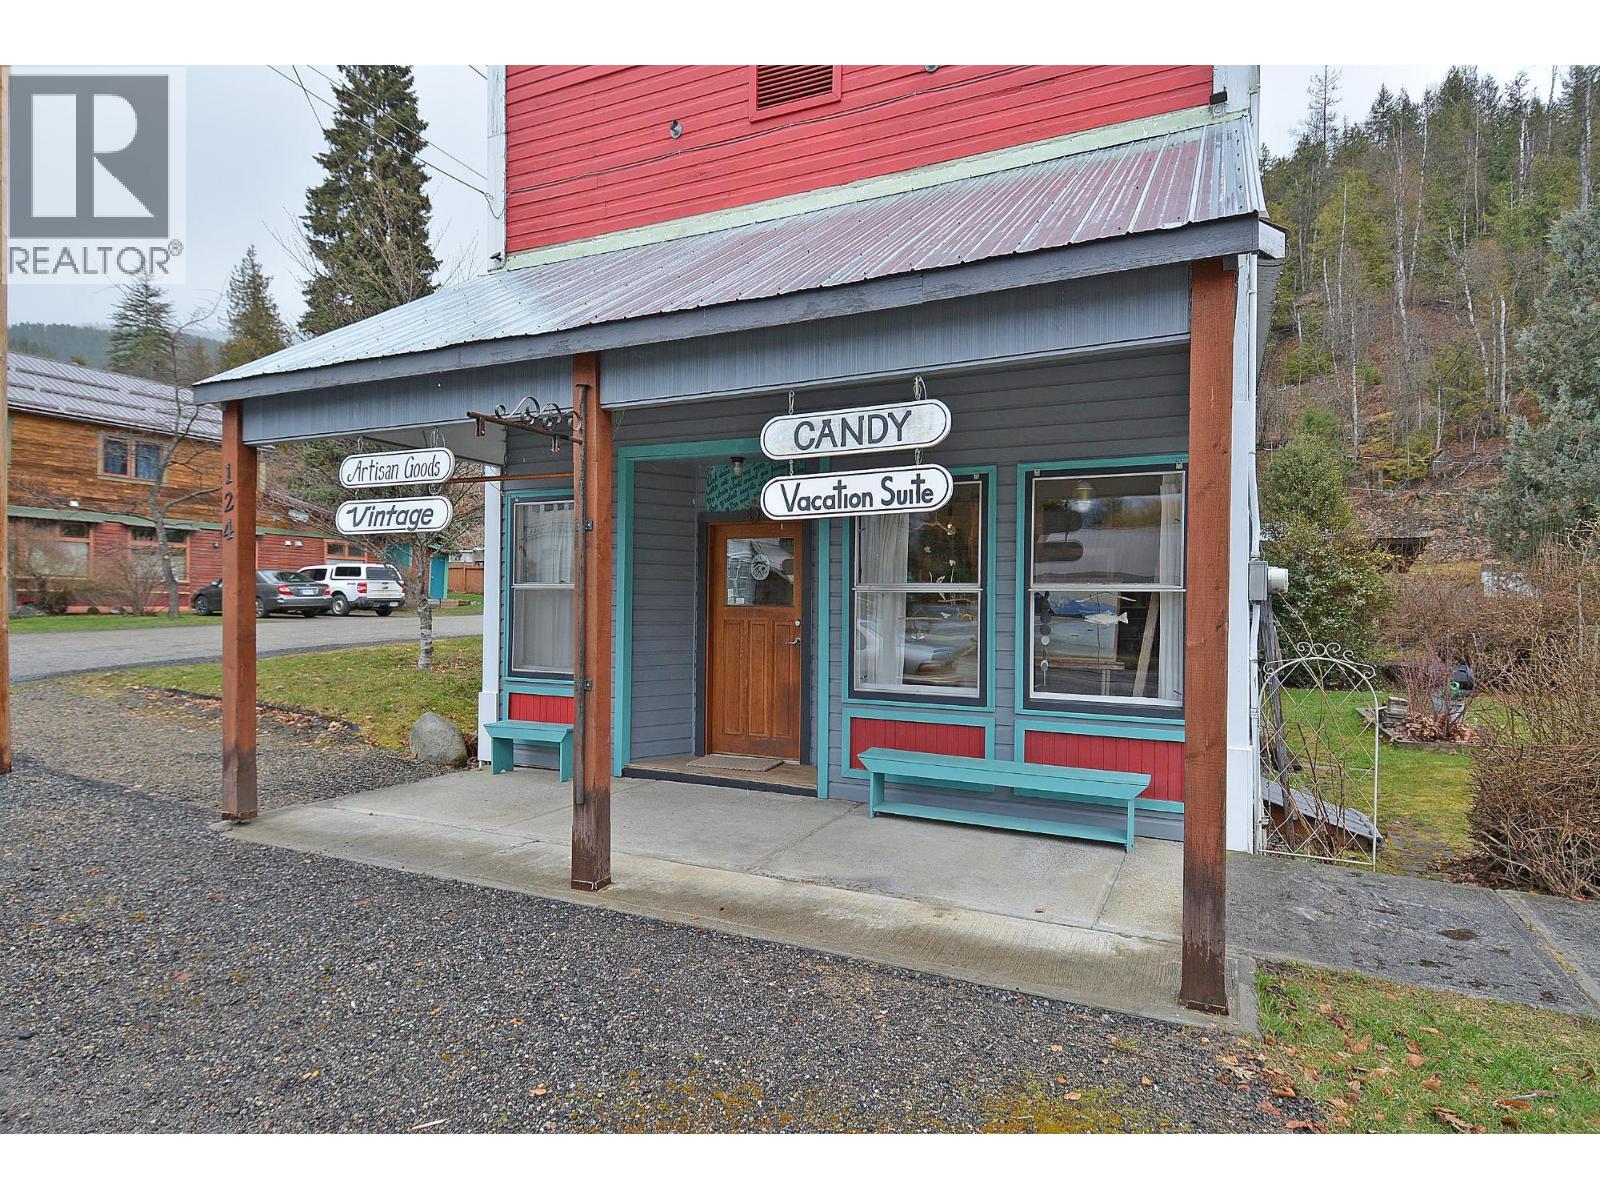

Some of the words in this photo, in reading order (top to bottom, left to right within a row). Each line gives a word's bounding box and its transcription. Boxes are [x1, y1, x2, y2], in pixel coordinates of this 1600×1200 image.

[793, 409, 912, 450] CANDY
[346, 459, 399, 483] Artisan
[404, 454, 441, 479] Goods
[780, 479, 874, 512] Vacation
[880, 473, 934, 506] Suite
[346, 504, 434, 531] Vintage
